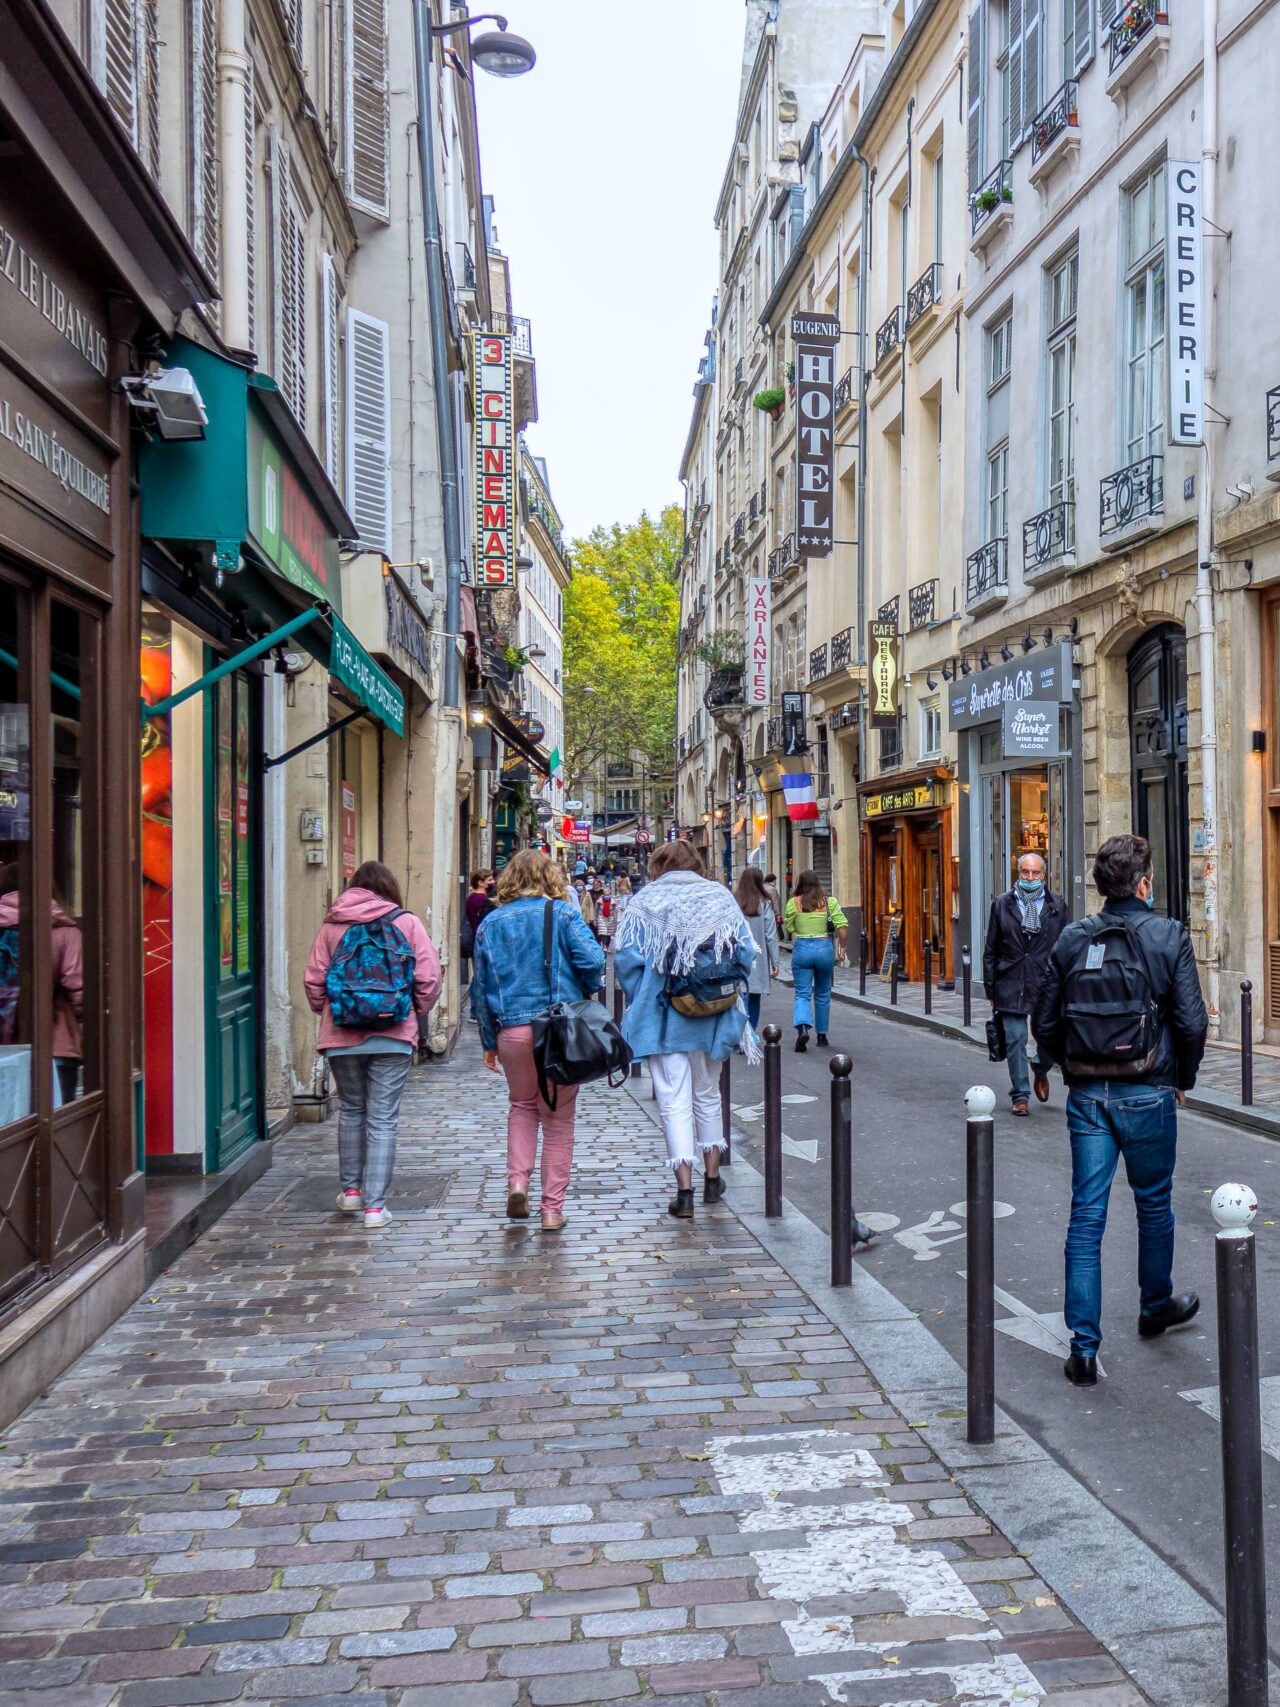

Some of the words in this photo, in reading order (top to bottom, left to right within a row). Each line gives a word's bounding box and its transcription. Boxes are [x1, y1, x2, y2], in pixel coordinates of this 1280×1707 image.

[18, 246, 38, 308] LE
[41, 270, 108, 378] LIBANAIS
[793, 320, 840, 337] EUGENIE
[483, 339, 503, 363] 3
[15, 411, 49, 469] SAIN
[51, 430, 110, 515] ÉQUILIBRÉ
[800, 353, 832, 529] HOTEL
[483, 394, 506, 583] CINEMAS
[753, 584, 767, 702] VARIANTES
[872, 624, 895, 636] CAFE
[880, 641, 889, 708] RESTAURANT
[1001, 675, 1015, 701] des
[1010, 723, 1054, 735] Market
[1014, 708, 1047, 724] Super
